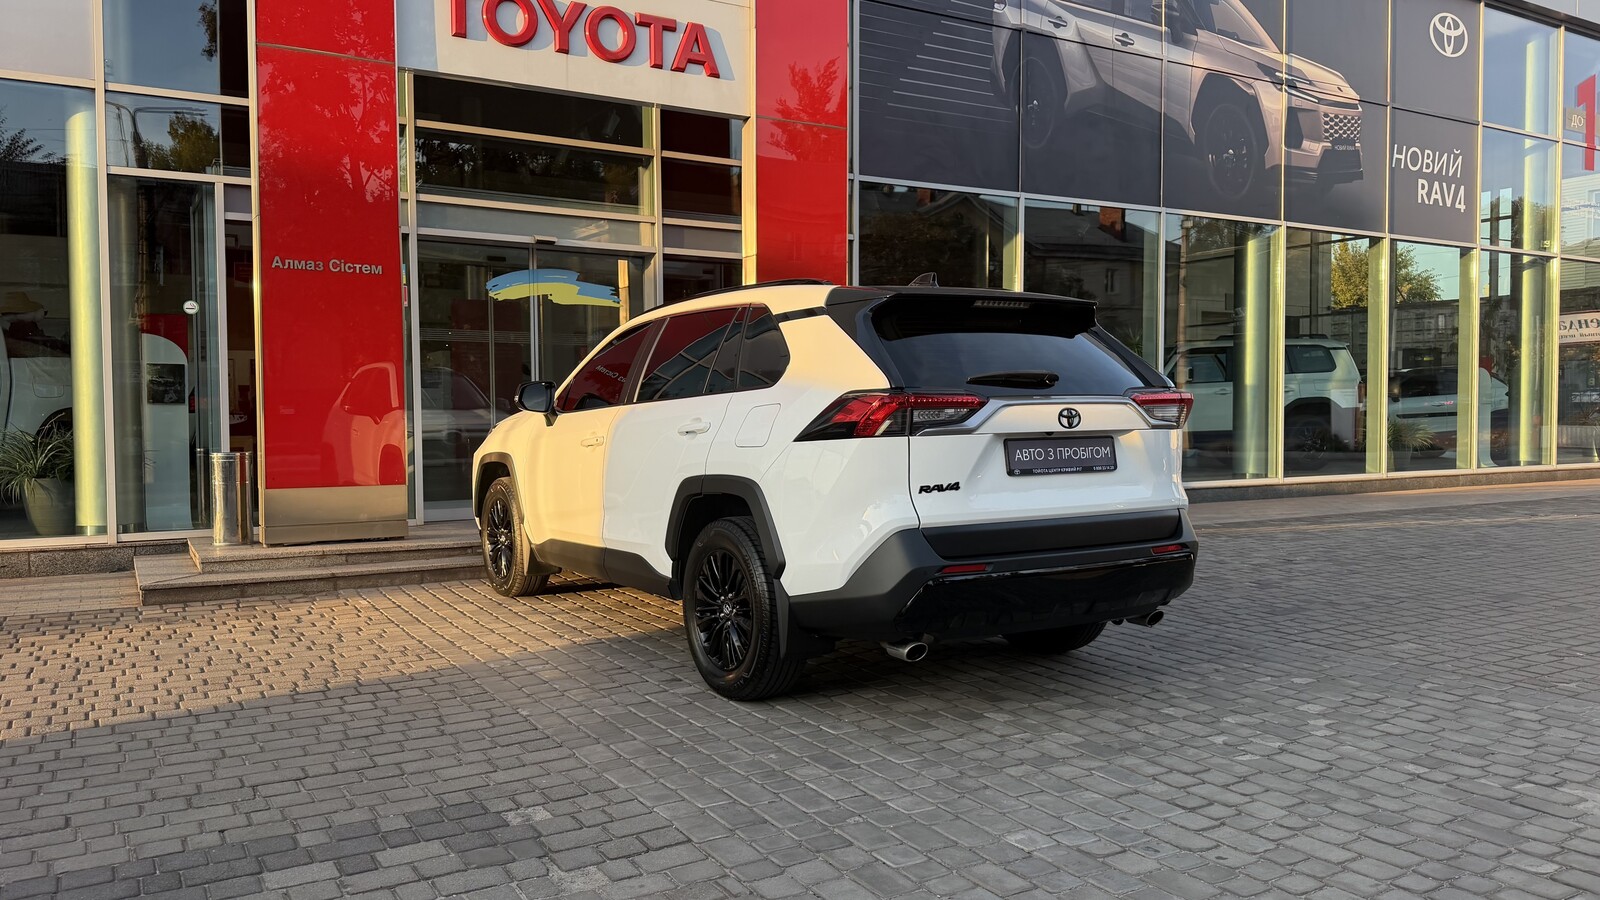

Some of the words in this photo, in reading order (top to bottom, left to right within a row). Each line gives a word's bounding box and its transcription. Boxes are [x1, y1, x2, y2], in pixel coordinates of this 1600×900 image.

[450, 0, 720, 79] TOYOTA
[1392, 144, 1463, 178] НОВИЙ
[1417, 178, 1466, 213] RAV4
[271, 255, 325, 271] Алмаз
[329, 258, 382, 275] Сістем
[1015, 448, 1045, 462] АВТО
[1057, 446, 1111, 460] ПРОБІГОМ
[918, 481, 961, 494] RAV4
